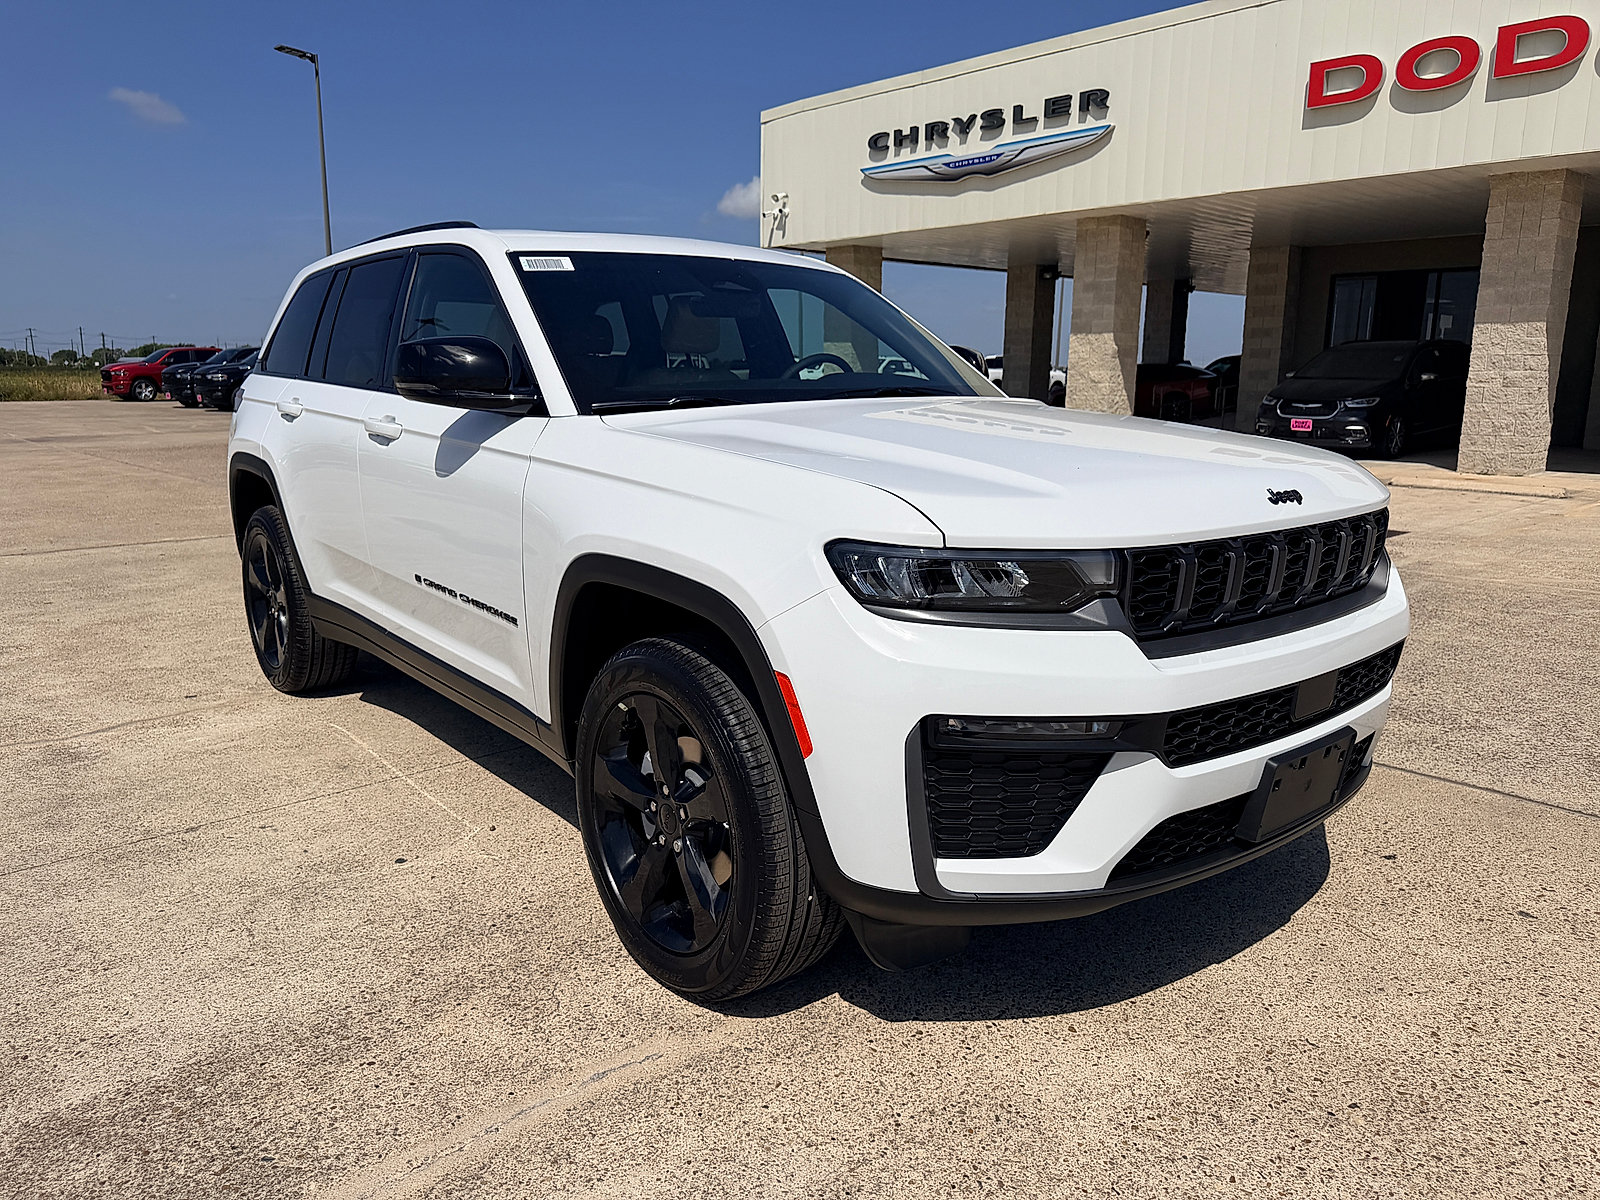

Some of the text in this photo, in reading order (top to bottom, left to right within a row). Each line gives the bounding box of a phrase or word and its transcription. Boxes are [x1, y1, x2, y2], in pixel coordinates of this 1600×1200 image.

[867, 88, 1110, 151] CHRYSLER
[949, 155, 997, 168] CHRYSLER
[1266, 488, 1303, 505] Jeep
[423, 578, 518, 628] GRAND CHEROKEE
